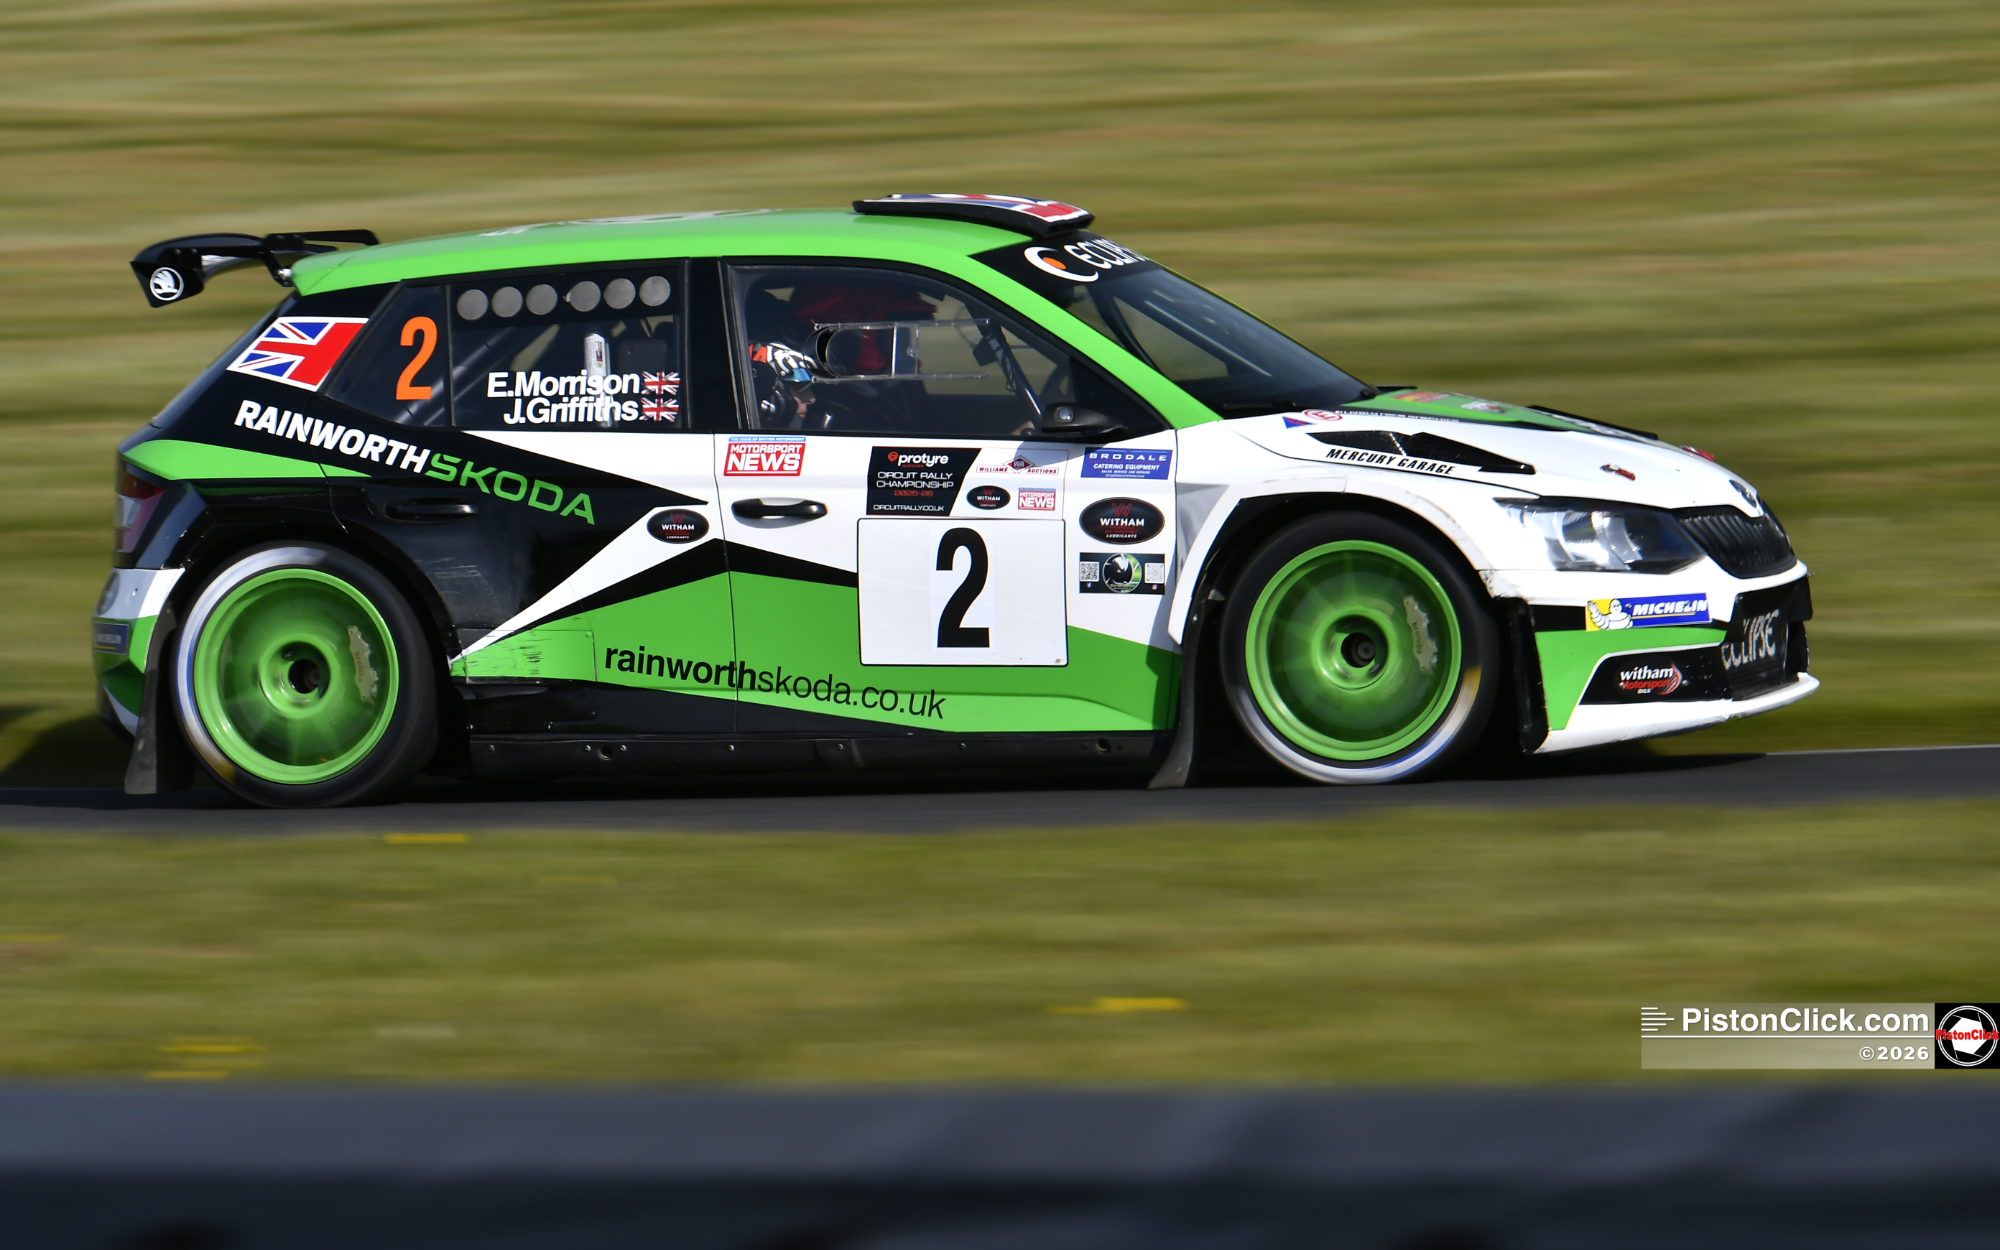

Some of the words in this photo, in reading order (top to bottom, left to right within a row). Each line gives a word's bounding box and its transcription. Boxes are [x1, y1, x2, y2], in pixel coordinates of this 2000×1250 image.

[395, 316, 438, 400] 2
[487, 369, 640, 398] E.Morrison
[503, 397, 639, 424] J.Griffiths
[730, 444, 803, 454] MOTORSPORT
[1089, 452, 1167, 462] BRODALE
[727, 453, 801, 471] NEWS
[897, 453, 949, 468] protyre
[1325, 449, 1396, 466] MERCURY
[1397, 458, 1456, 475] GARAGE
[877, 471, 918, 479] CIRCUIT
[920, 472, 953, 480] RALLY
[876, 480, 954, 489] CHAMPIONSHIP
[1019, 498, 1055, 508] NEWS
[1099, 517, 1145, 527] WITHAM
[935, 527, 990, 648] 2
[1632, 599, 1708, 616] MICHELIN
[1620, 665, 1674, 681] witham
[604, 645, 947, 719] rainworthskoda.co.uk
